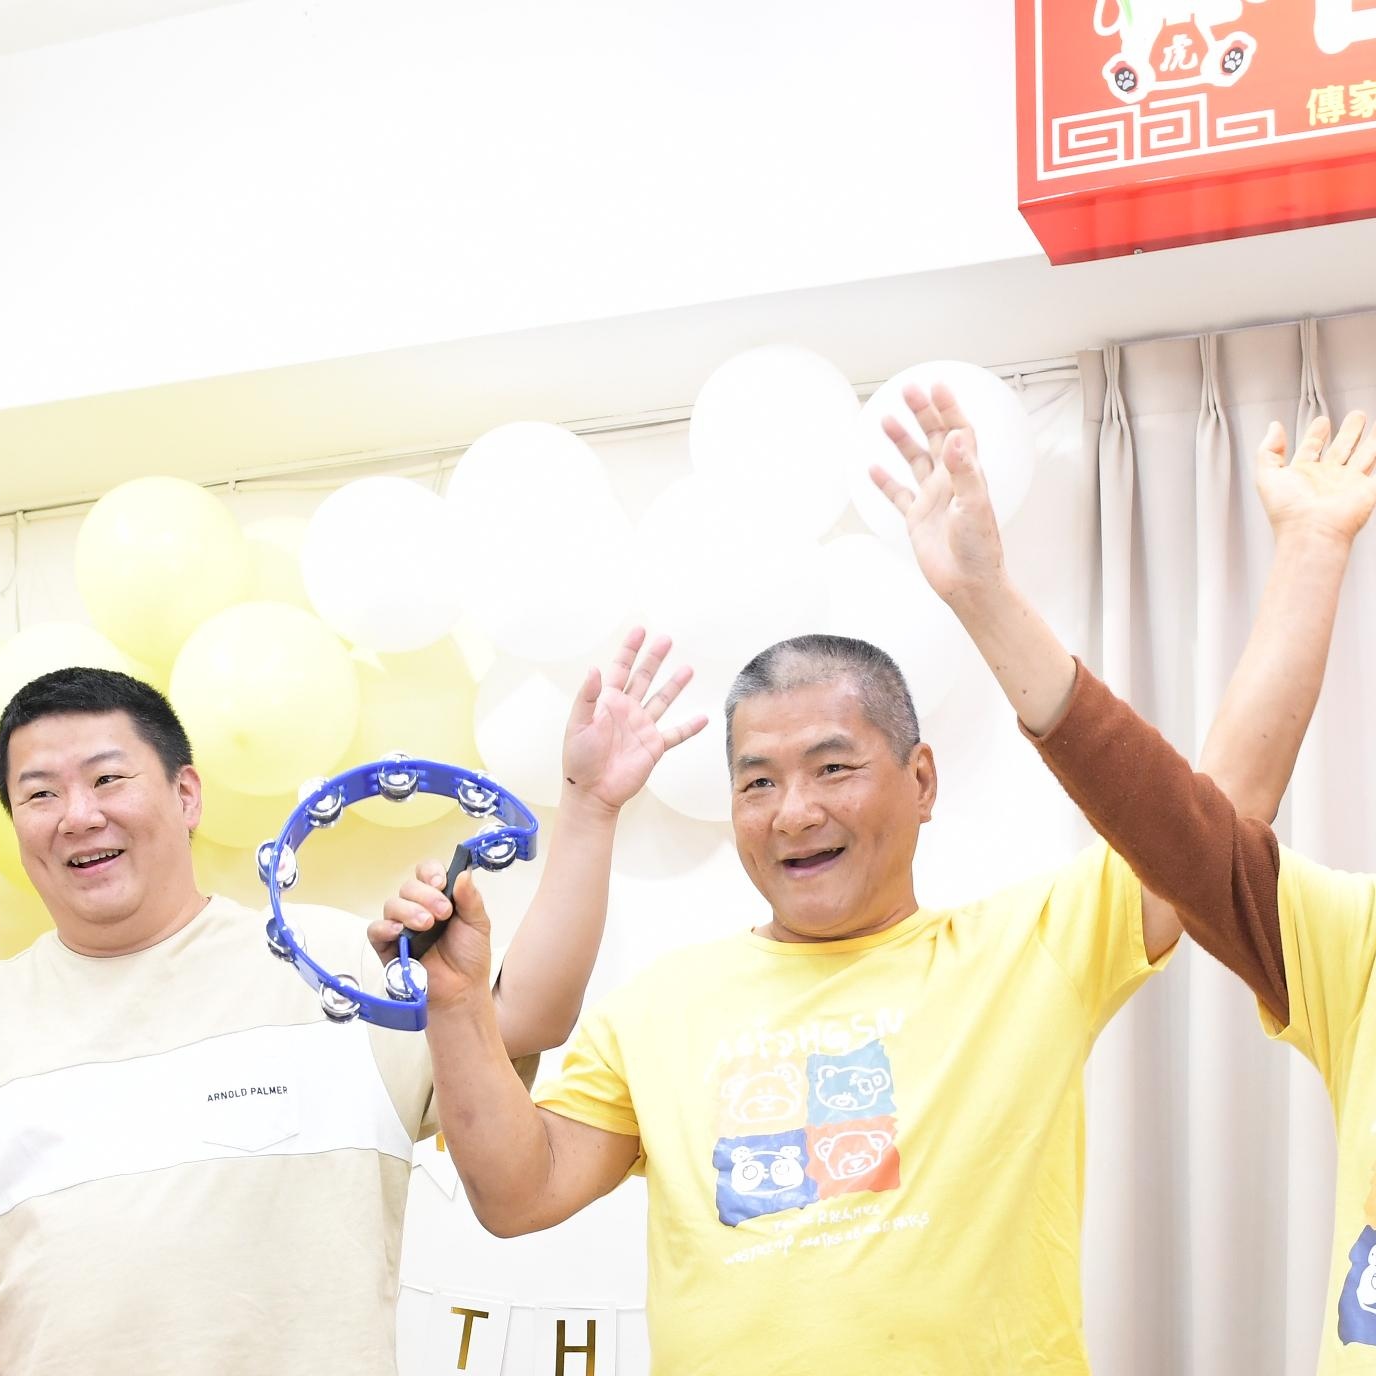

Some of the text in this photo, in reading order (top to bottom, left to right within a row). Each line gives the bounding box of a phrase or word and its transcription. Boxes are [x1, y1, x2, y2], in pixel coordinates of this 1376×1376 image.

[1159, 33, 1199, 72] 虎
[207, 1086, 288, 1102] ARNOLD PALMER
